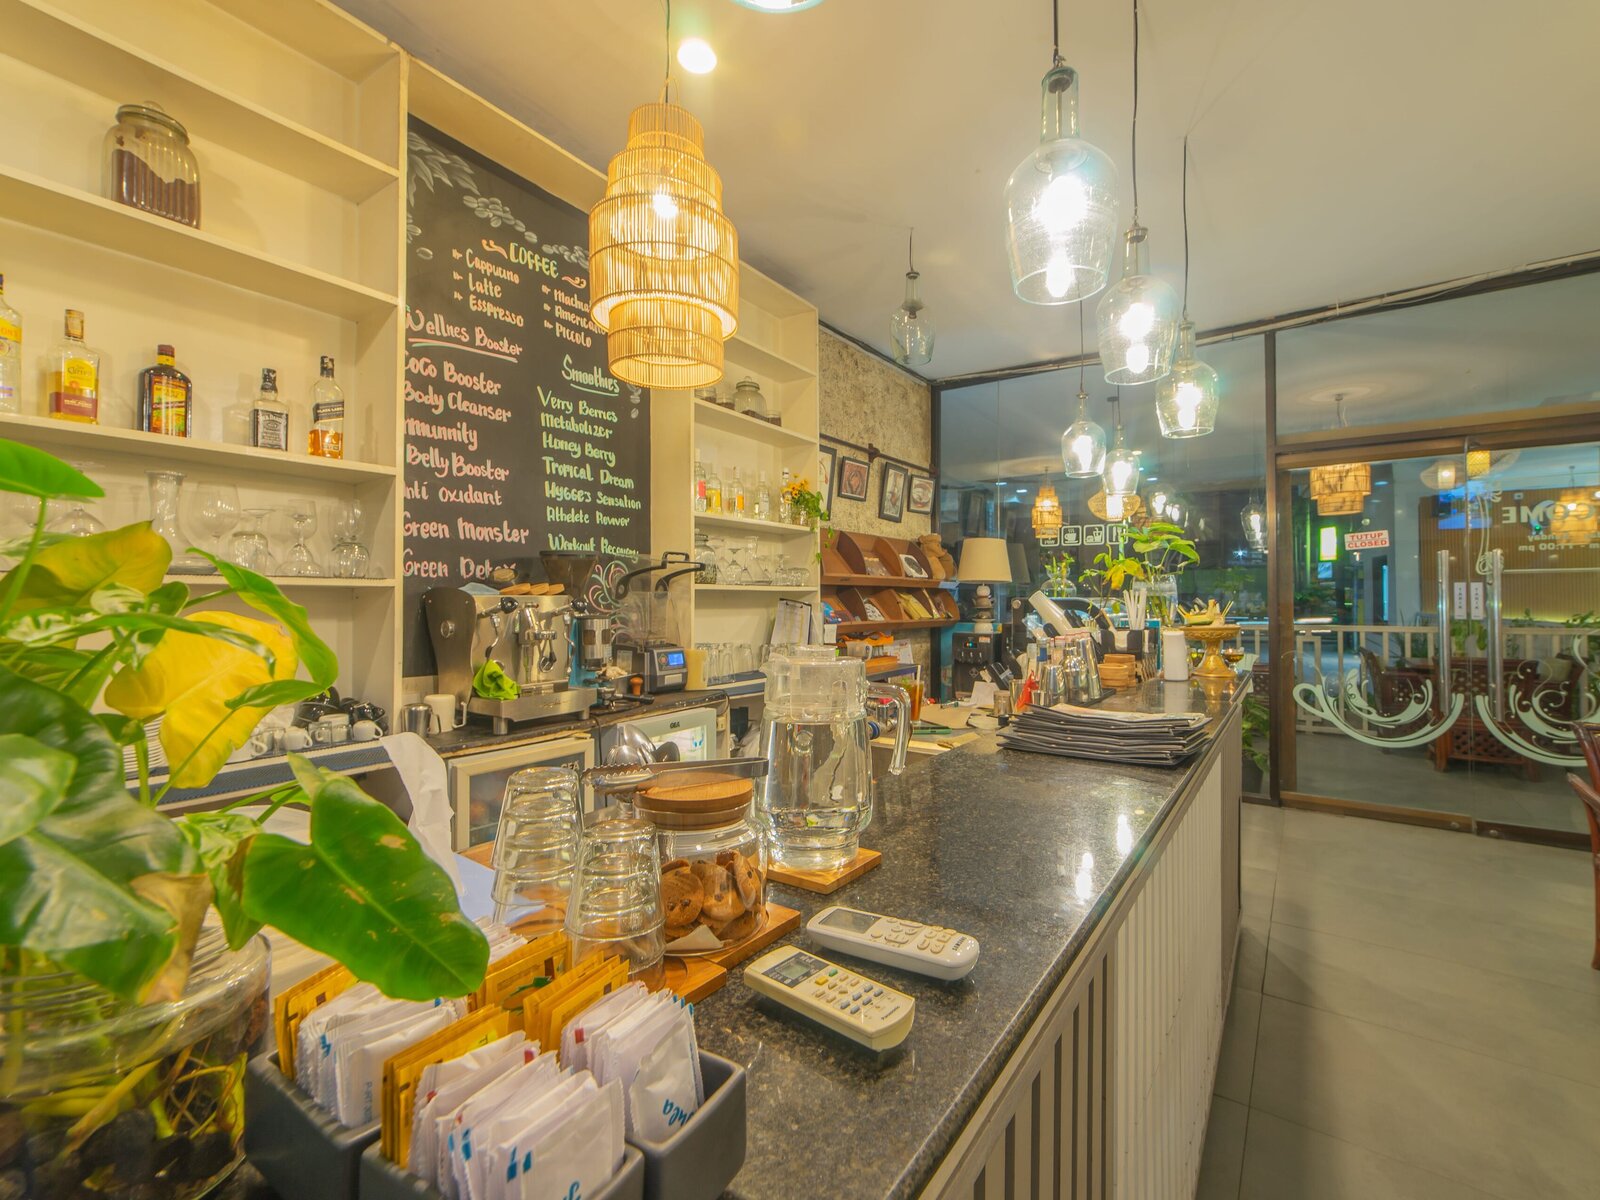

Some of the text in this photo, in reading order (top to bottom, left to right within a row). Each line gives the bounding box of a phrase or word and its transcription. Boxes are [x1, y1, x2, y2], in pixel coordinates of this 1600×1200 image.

[509, 242, 559, 278] COFFEE
[468, 273, 502, 298] Latte
[554, 289, 591, 313] Machia
[474, 325, 523, 355] Booster
[555, 322, 592, 348] Piccolo
[443, 360, 501, 395] Booster
[562, 353, 620, 393] Smoothies
[404, 380, 512, 422] Body Cleanser
[578, 400, 618, 423] Berries
[540, 412, 613, 439] Metabolizer
[406, 443, 510, 481] Belly Booster
[542, 431, 616, 468] Honey Berry
[542, 456, 635, 489] Tropical Dream
[404, 480, 429, 500] nti
[596, 491, 641, 510] Sensation
[403, 511, 530, 544] Green Monster
[1349, 531, 1384, 541] TUTUP
[547, 533, 596, 552] Workout
[1347, 540, 1388, 549] CLOSED
[403, 548, 516, 580] Green Det
